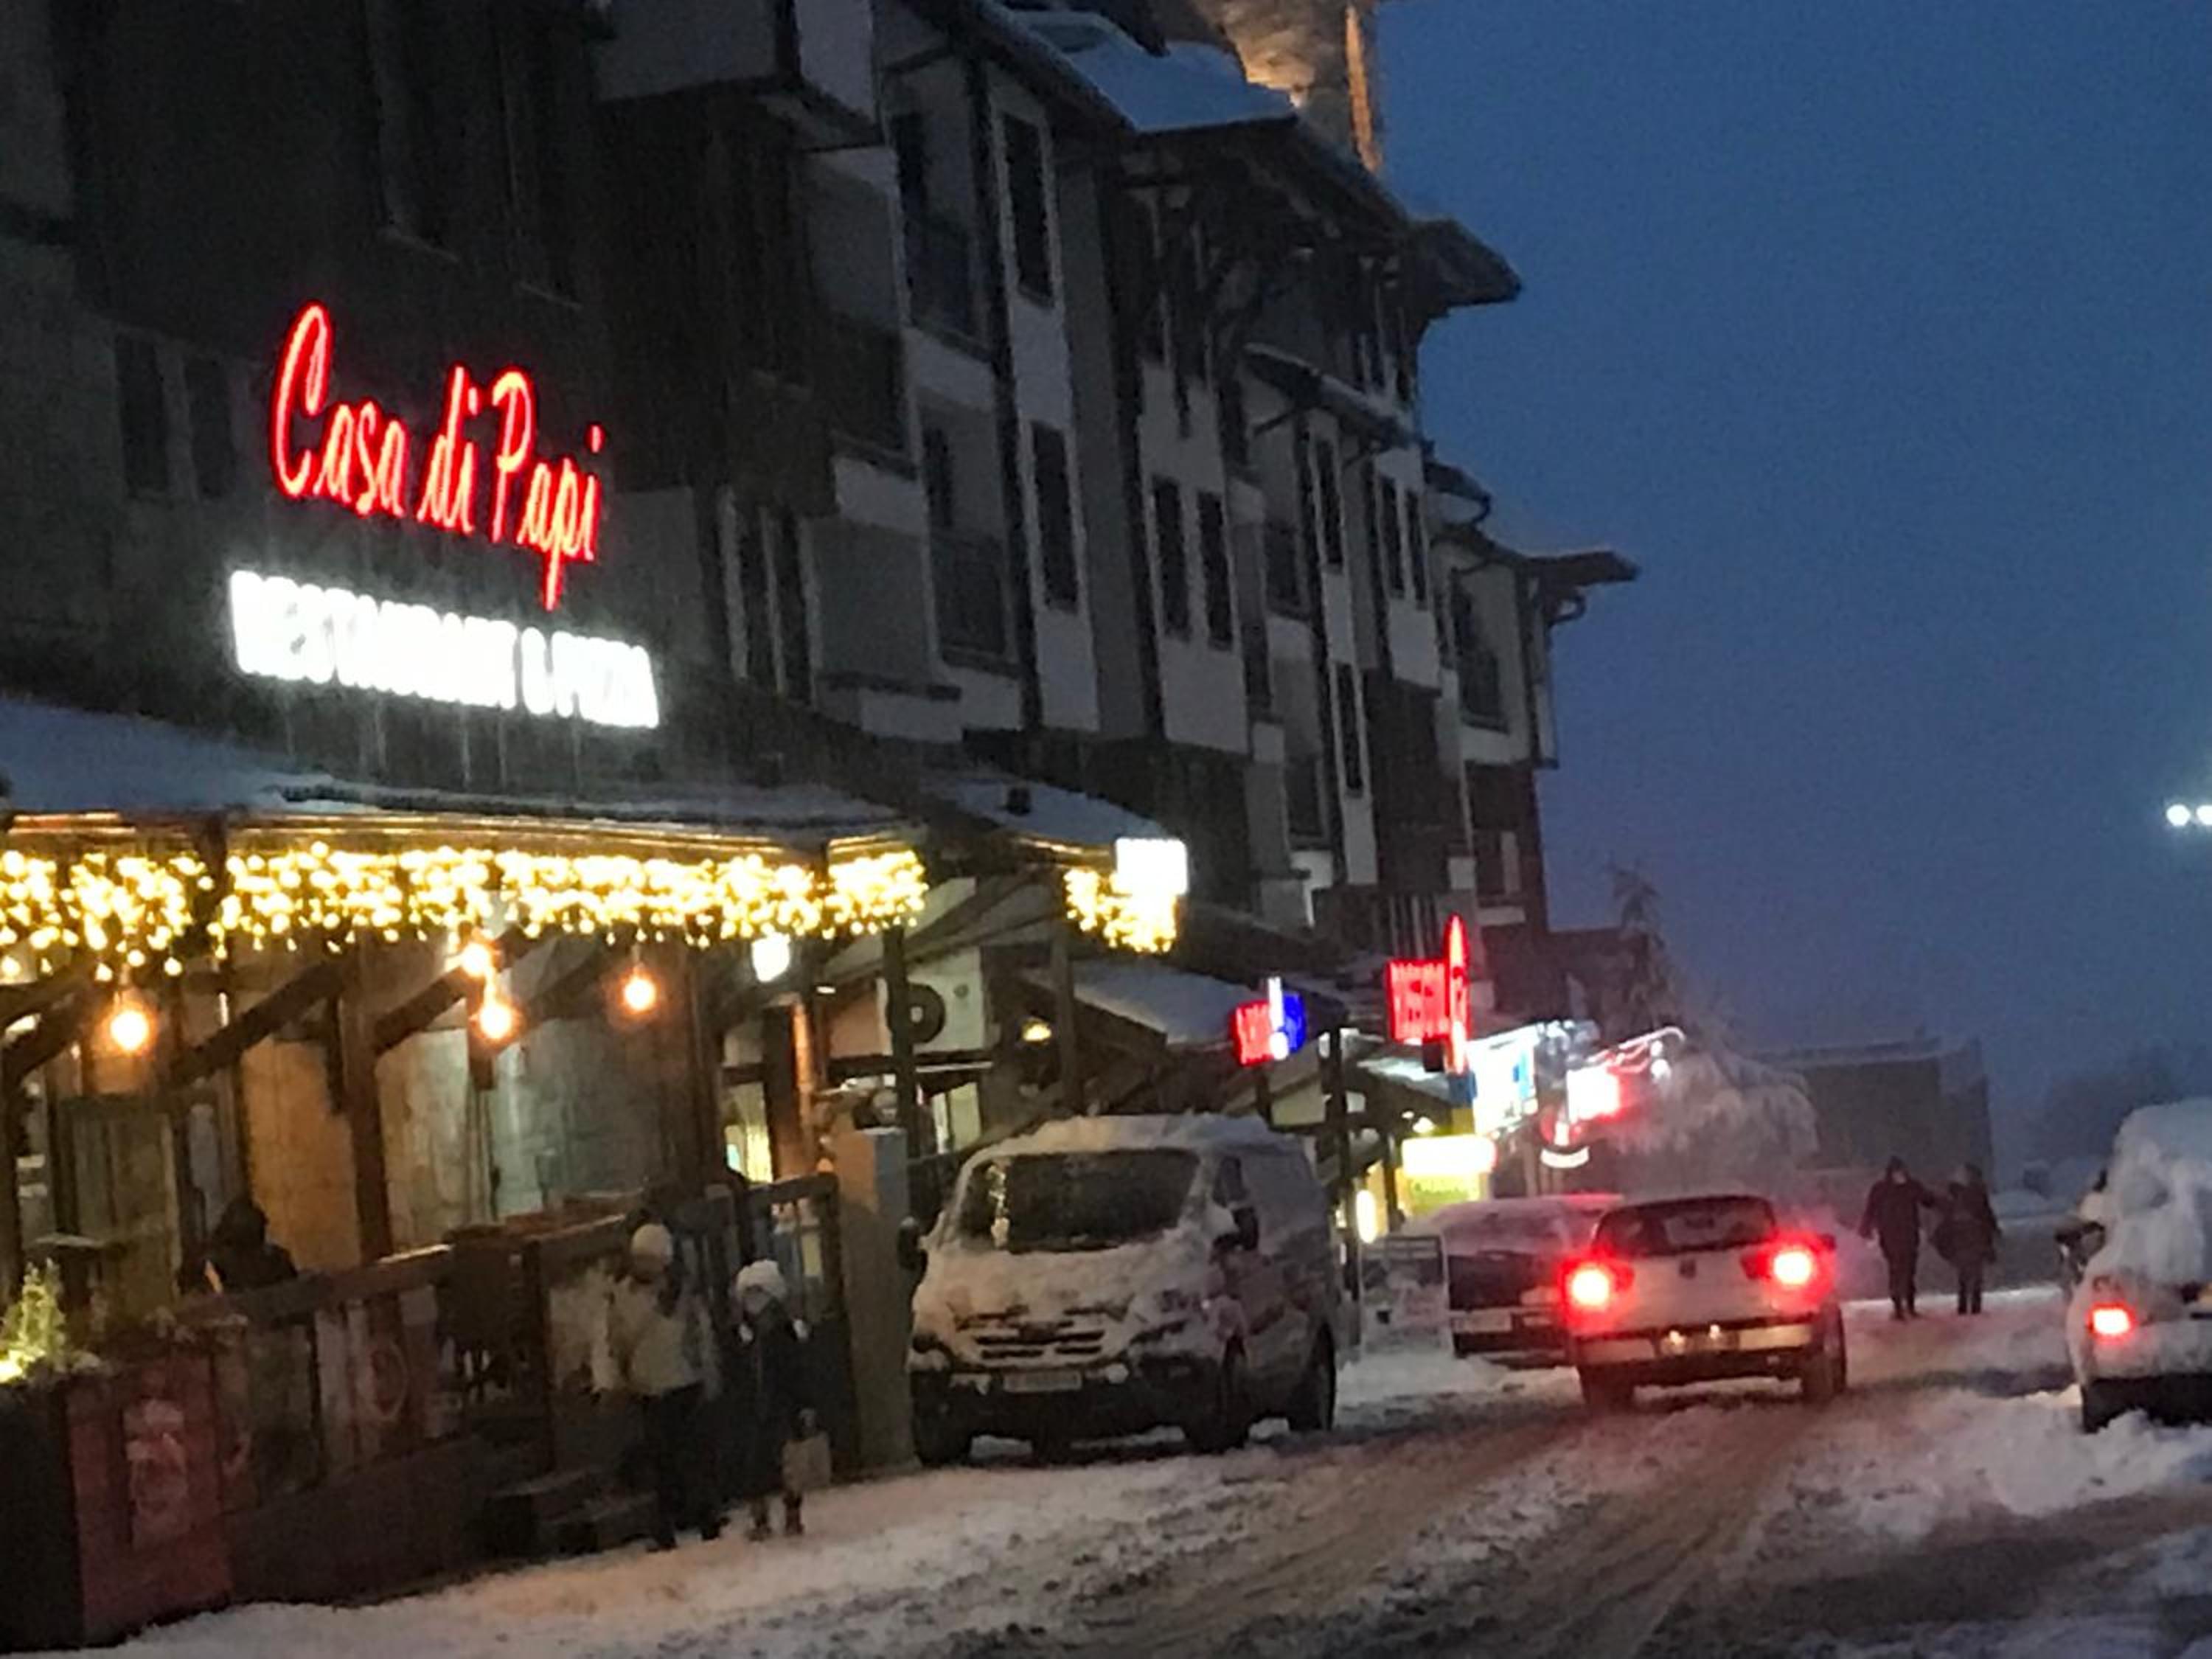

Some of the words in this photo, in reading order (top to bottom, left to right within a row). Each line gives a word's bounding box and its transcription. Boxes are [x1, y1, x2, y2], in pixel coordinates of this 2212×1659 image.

[271, 302, 409, 518] Casa
[415, 363, 481, 536] di
[490, 368, 605, 613] Papi
